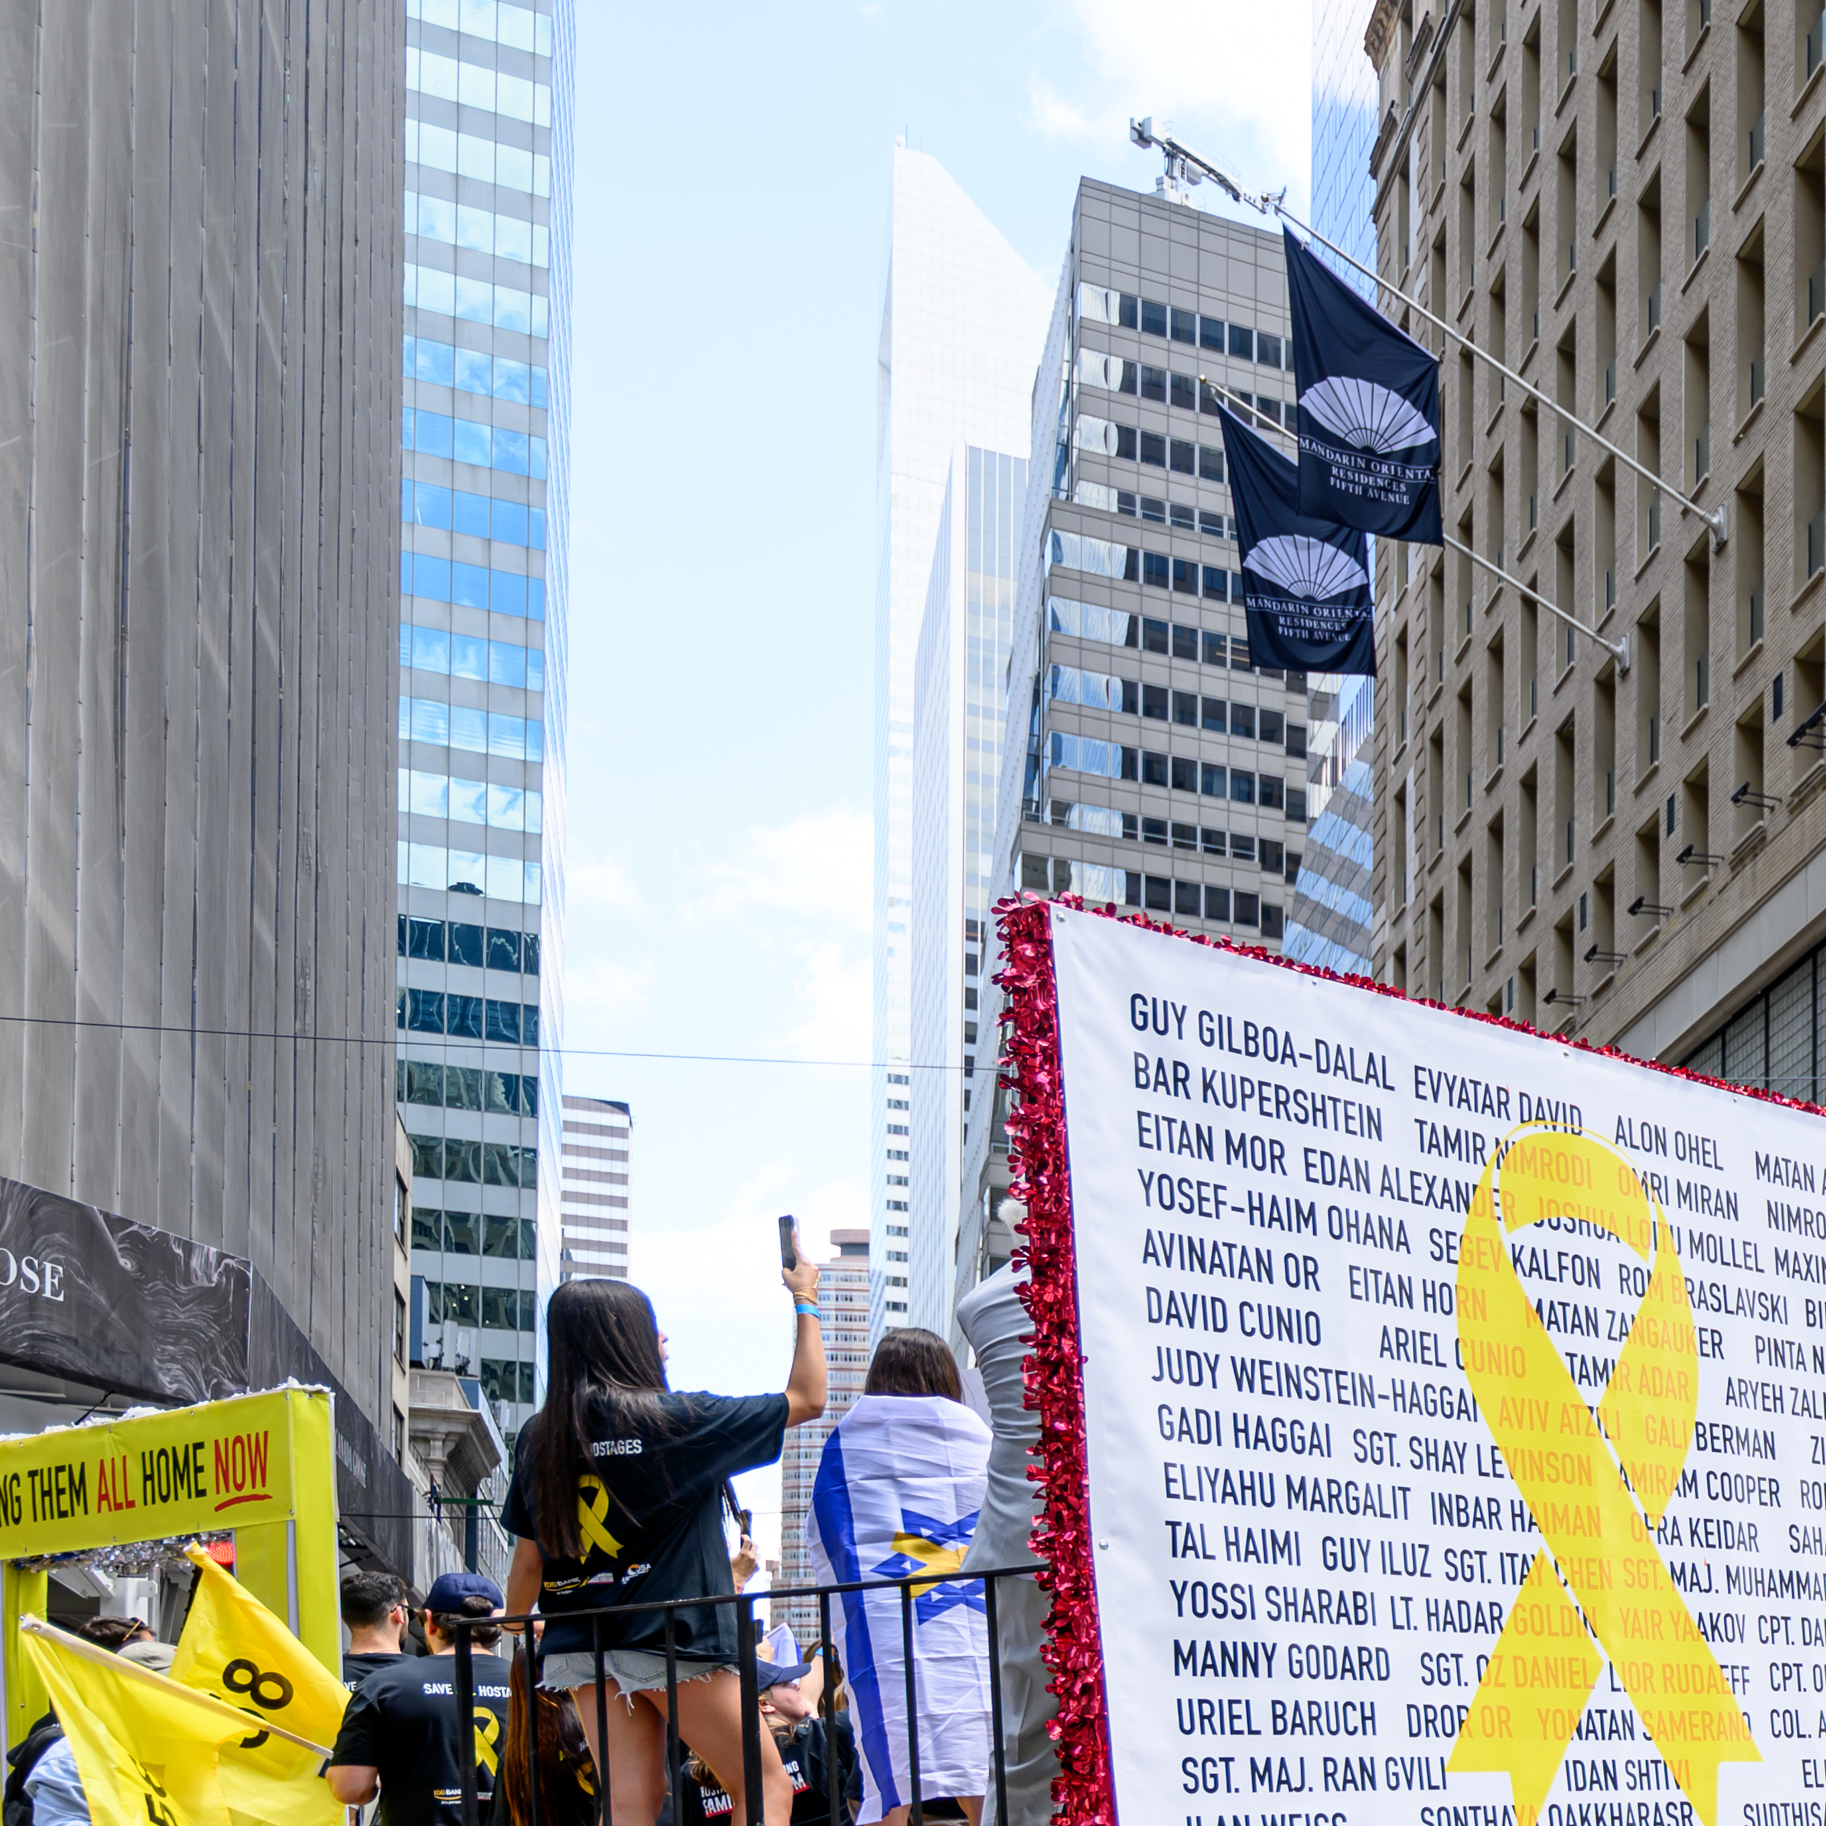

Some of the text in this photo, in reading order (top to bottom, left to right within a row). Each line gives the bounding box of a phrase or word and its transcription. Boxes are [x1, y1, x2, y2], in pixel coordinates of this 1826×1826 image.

[1299, 437, 1436, 481] MANDARIN ORIENTA
[1331, 465, 1407, 493] RESIDENCES
[1330, 477, 1410, 505] FIFTH AVENUE
[1246, 597, 1310, 617] MANDARIN
[1278, 616, 1347, 632] RESIDENCES
[1129, 991, 1189, 1042] GUY
[1197, 1008, 1394, 1091] GILBOA-DALAL
[1413, 1065, 1511, 1120] EVYATAR
[1518, 1091, 1583, 1138] DAVID
[1613, 1114, 1668, 1156] ALON
[1673, 1130, 1723, 1170] OHEL
[1754, 1151, 1815, 1192] MATAN
[1138, 1168, 1318, 1237] YOSEF-HAIM
[1326, 1204, 1411, 1253] OHANA
[1428, 1224, 1504, 1273] SEGEV
[1511, 1242, 1601, 1290] KALFON
[1618, 1262, 1664, 1303] ROM
[1670, 1272, 1788, 1326] BRASLAVSKI
[1146, 1286, 1228, 1333] DAVID
[1238, 1300, 1322, 1346] CUNIO
[1377, 1324, 1447, 1367] ARIEL
[1453, 1334, 1527, 1379] CUNIO
[1565, 1351, 1632, 1394] TAMIR
[1637, 1363, 1690, 1403] ADAR
[1724, 1376, 1784, 1413] ARYEH
[27, 1461, 89, 1523] THEM
[97, 1454, 136, 1514] ALL
[141, 1441, 207, 1507] HOME
[213, 1430, 269, 1496] NOW
[1164, 1462, 1275, 1507] ELIYAHU
[1285, 1475, 1412, 1519] MARGALIT
[1430, 1492, 1502, 1529] INBAR
[1509, 1496, 1602, 1538] HAIMAN
[1629, 1508, 1682, 1545] OFRA
[1689, 1516, 1759, 1551] KEIDAR
[423, 1683, 454, 1696] SAVE
[1181, 1757, 1240, 1797] SGT.
[1249, 1757, 1313, 1796] MAJ.
[1322, 1757, 1376, 1795] RAN
[1384, 1757, 1447, 1794] GVILI
[1565, 1759, 1618, 1790] IDAN
[1624, 1756, 1691, 1791] SHTIVI
